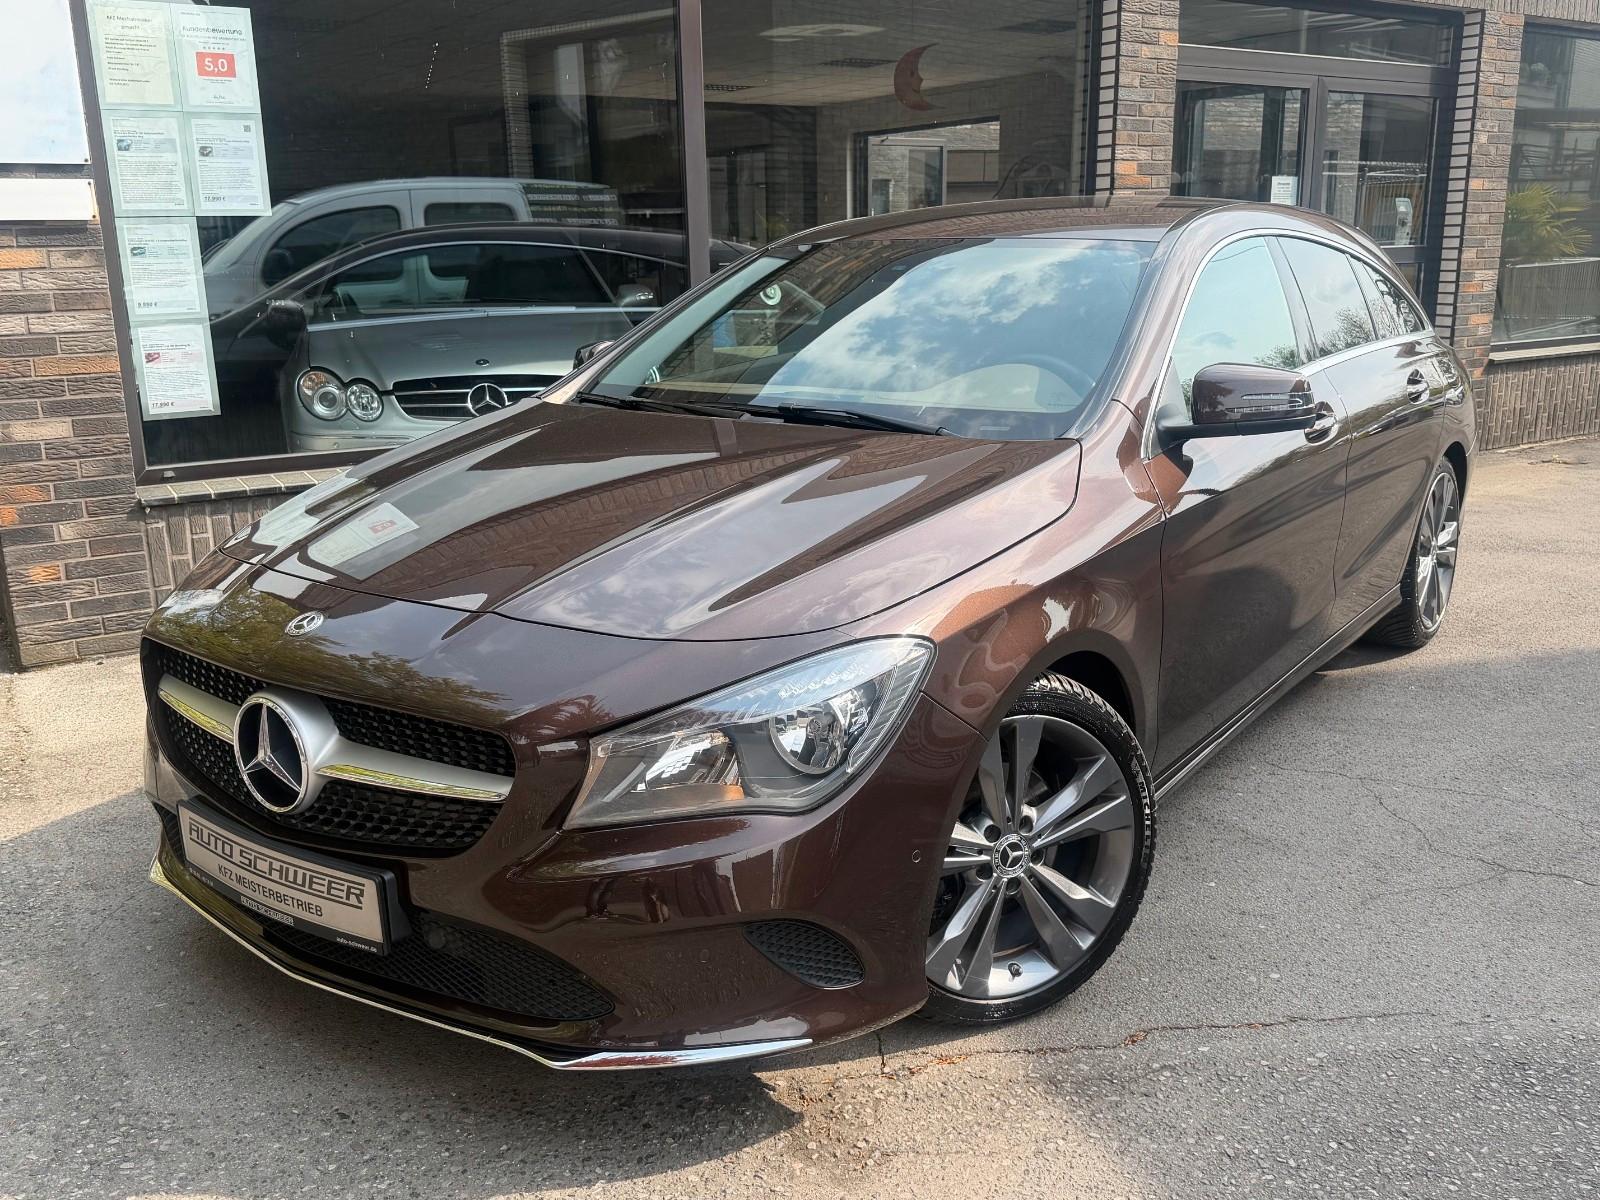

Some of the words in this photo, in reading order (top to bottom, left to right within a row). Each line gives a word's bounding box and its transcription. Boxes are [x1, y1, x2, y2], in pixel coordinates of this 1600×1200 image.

[204, 57, 228, 73] 5,0
[189, 822, 233, 860] AUTO
[239, 849, 365, 905] SCHWEER
[217, 862, 235, 882] KFZ
[235, 874, 323, 917] MEISTERBETRIEB
